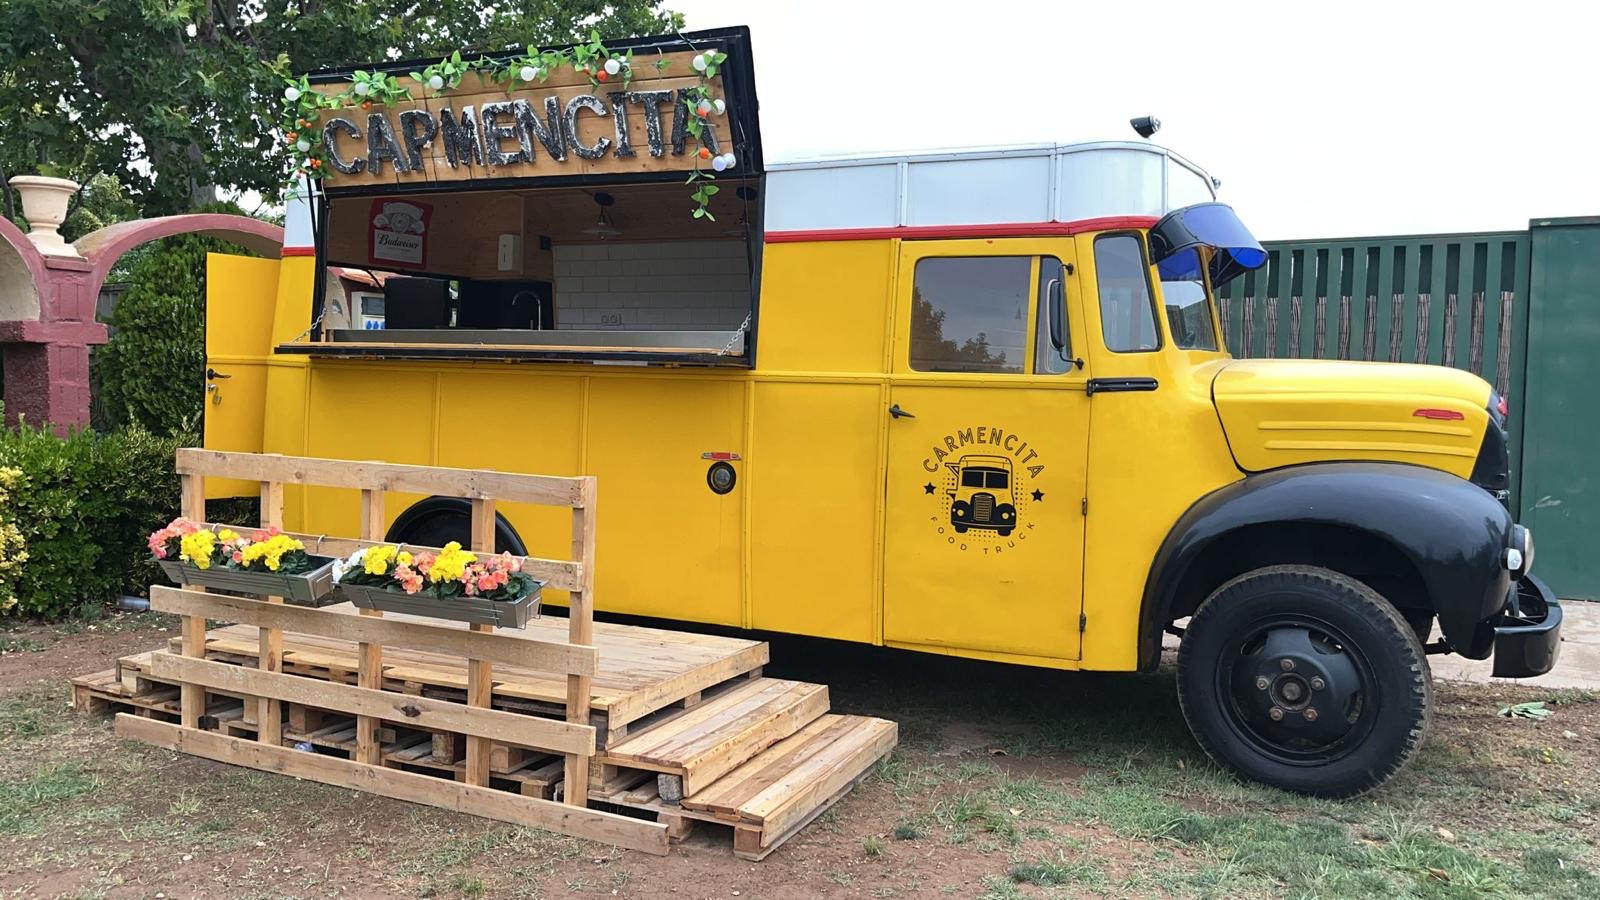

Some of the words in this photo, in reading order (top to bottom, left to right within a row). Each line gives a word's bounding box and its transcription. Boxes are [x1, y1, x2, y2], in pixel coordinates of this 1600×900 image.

[377, 233, 420, 249] Budweiser
[922, 426, 1045, 479] CARMENCITA
[930, 516, 968, 551] FOOD
[983, 522, 1035, 555] TRUCK
